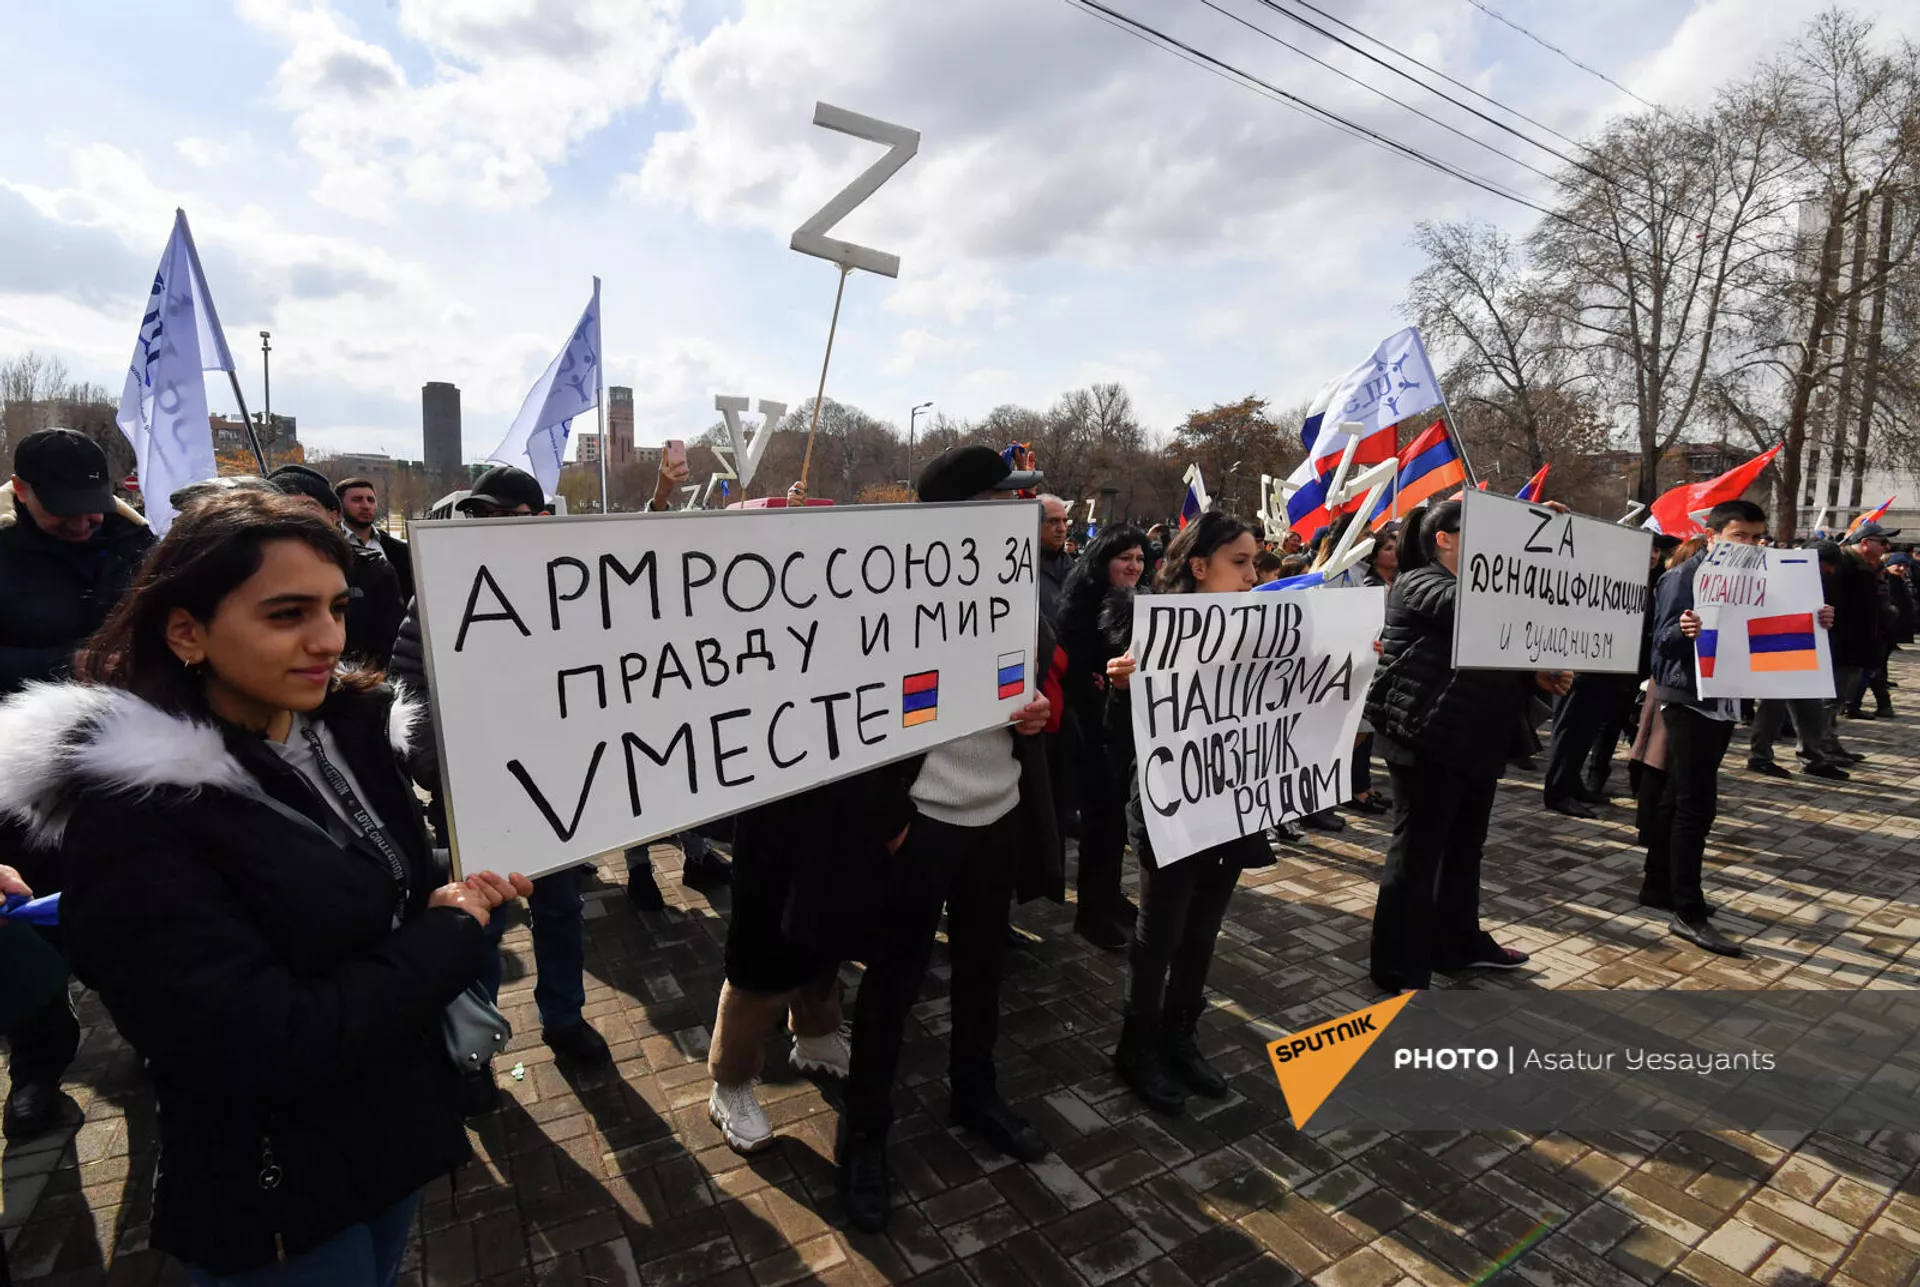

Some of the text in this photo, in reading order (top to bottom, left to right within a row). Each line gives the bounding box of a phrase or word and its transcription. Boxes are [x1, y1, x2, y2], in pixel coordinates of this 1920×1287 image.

[454, 536, 1034, 652] АРМРОССОЮЗ ЗА
[1140, 602, 1303, 672] ПРОТИВ
[557, 596, 1011, 718] ПРАВДУ И МИР
[1525, 621, 1613, 662] гуманизм
[1145, 651, 1353, 739] НАЦИЗМА
[1145, 712, 1302, 817] СОЮЗНИК
[353, 809, 376, 836] LOVE
